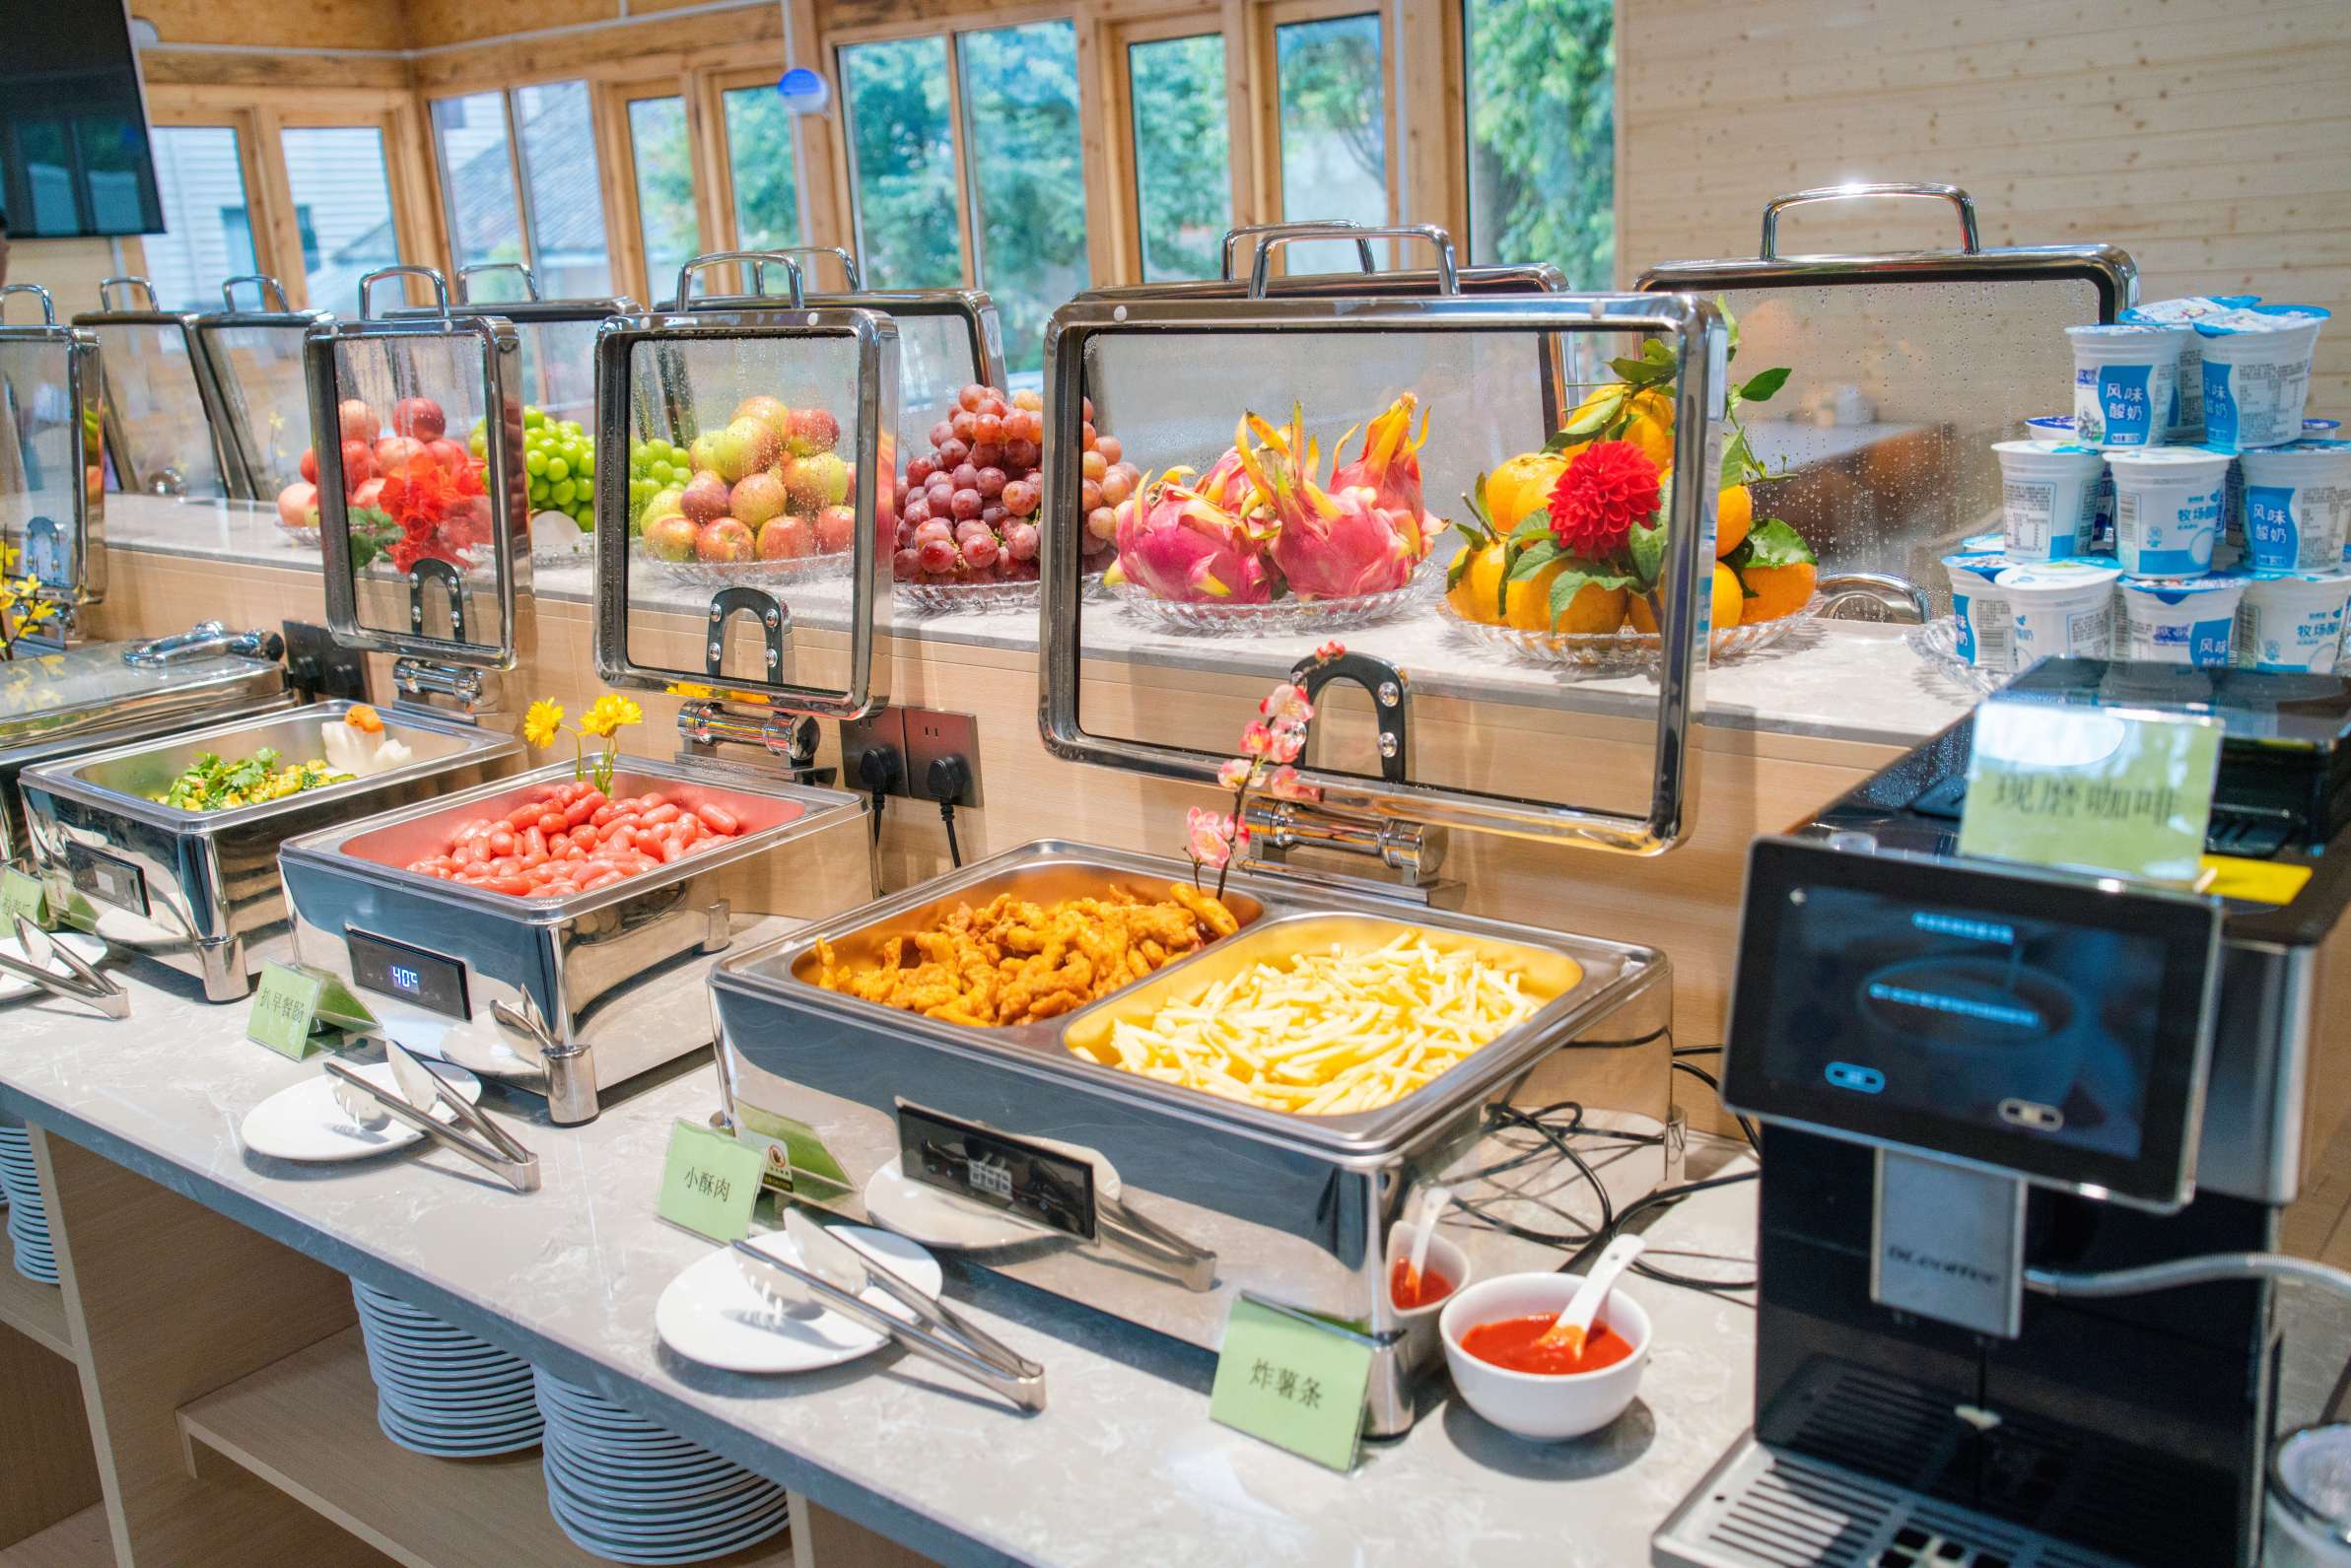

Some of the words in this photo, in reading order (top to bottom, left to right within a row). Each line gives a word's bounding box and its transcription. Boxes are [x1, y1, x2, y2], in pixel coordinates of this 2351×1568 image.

[2106, 382, 2144, 403] 风味
[2109, 402, 2143, 422] 酸奶
[2253, 503, 2288, 525] 风味
[2254, 523, 2288, 544] 酸奶
[684, 1166, 730, 1202] 小酥肉
[1249, 1357, 1322, 1409] 炸薯条
